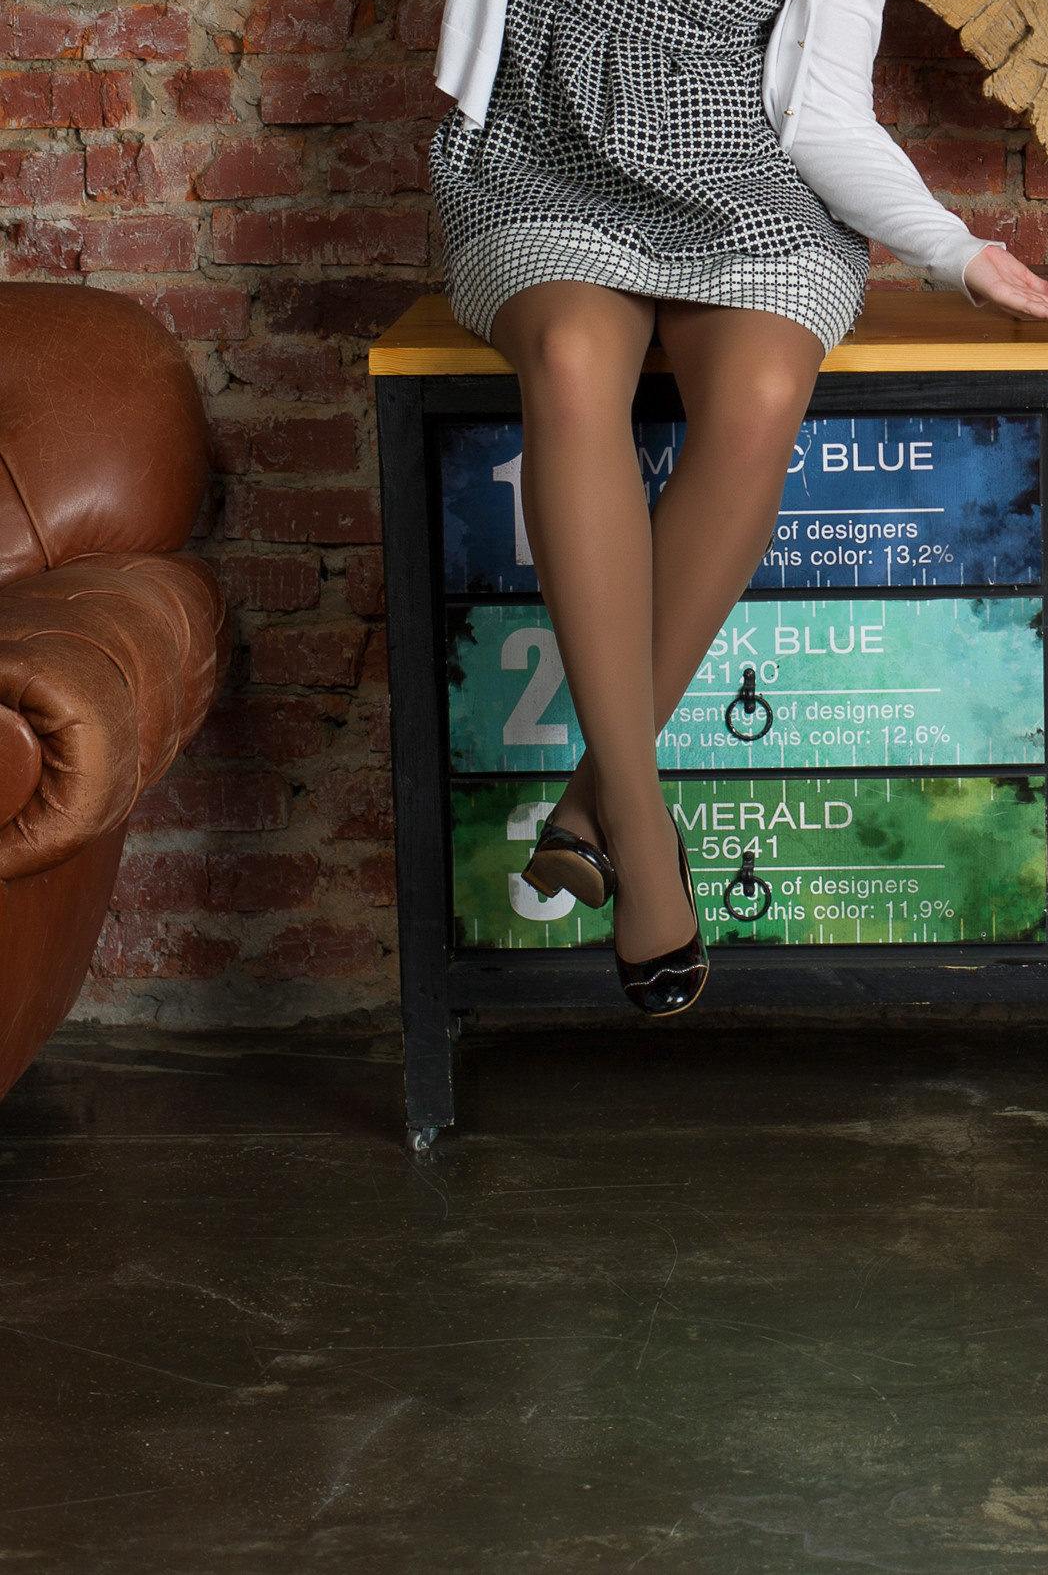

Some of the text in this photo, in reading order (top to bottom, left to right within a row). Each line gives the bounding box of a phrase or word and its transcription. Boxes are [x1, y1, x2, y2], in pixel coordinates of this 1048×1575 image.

[822, 441, 934, 473] BLUE
[777, 519, 919, 544] of designers
[810, 545, 874, 567] color:
[883, 544, 955, 567] 13,2%
[707, 625, 885, 657] SK BLUE
[696, 660, 779, 685] 4120
[500, 627, 568, 746] 2
[671, 701, 915, 727] rsentage of designers
[656, 724, 951, 748] ho used this color: 12,6%
[672, 801, 853, 832] MERALD
[686, 834, 779, 860] -5641
[781, 876, 803, 896] of
[812, 875, 920, 900] designers
[704, 898, 955, 922] used this color: 11,9%
